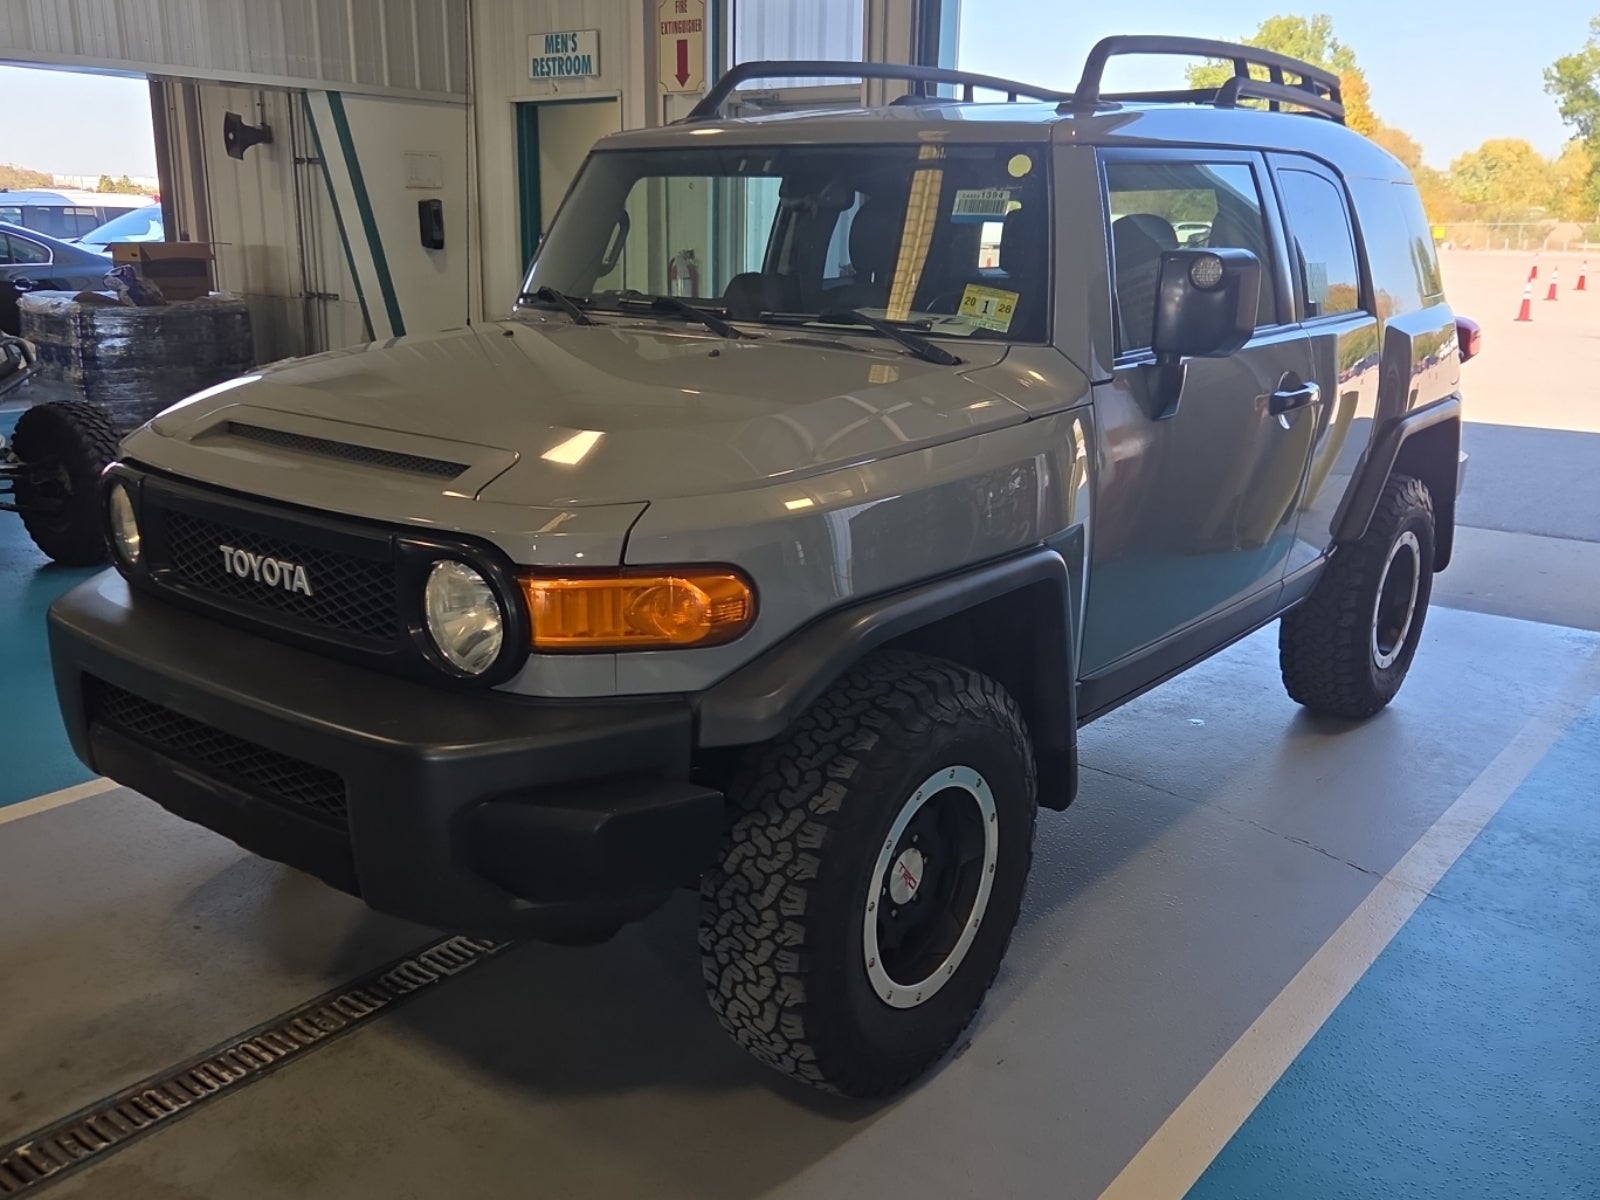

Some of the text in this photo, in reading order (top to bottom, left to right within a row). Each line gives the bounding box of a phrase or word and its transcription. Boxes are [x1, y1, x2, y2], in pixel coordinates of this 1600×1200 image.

[675, 0, 688, 14] FIRE
[661, 18, 702, 35] EXTINGUISHER
[544, 33, 577, 54] MEN'S
[532, 55, 592, 76] RESTROOM
[964, 296, 976, 307] 20
[982, 300, 990, 314] 1
[219, 545, 312, 596] TOYOTA
[899, 861, 917, 889] TRD
